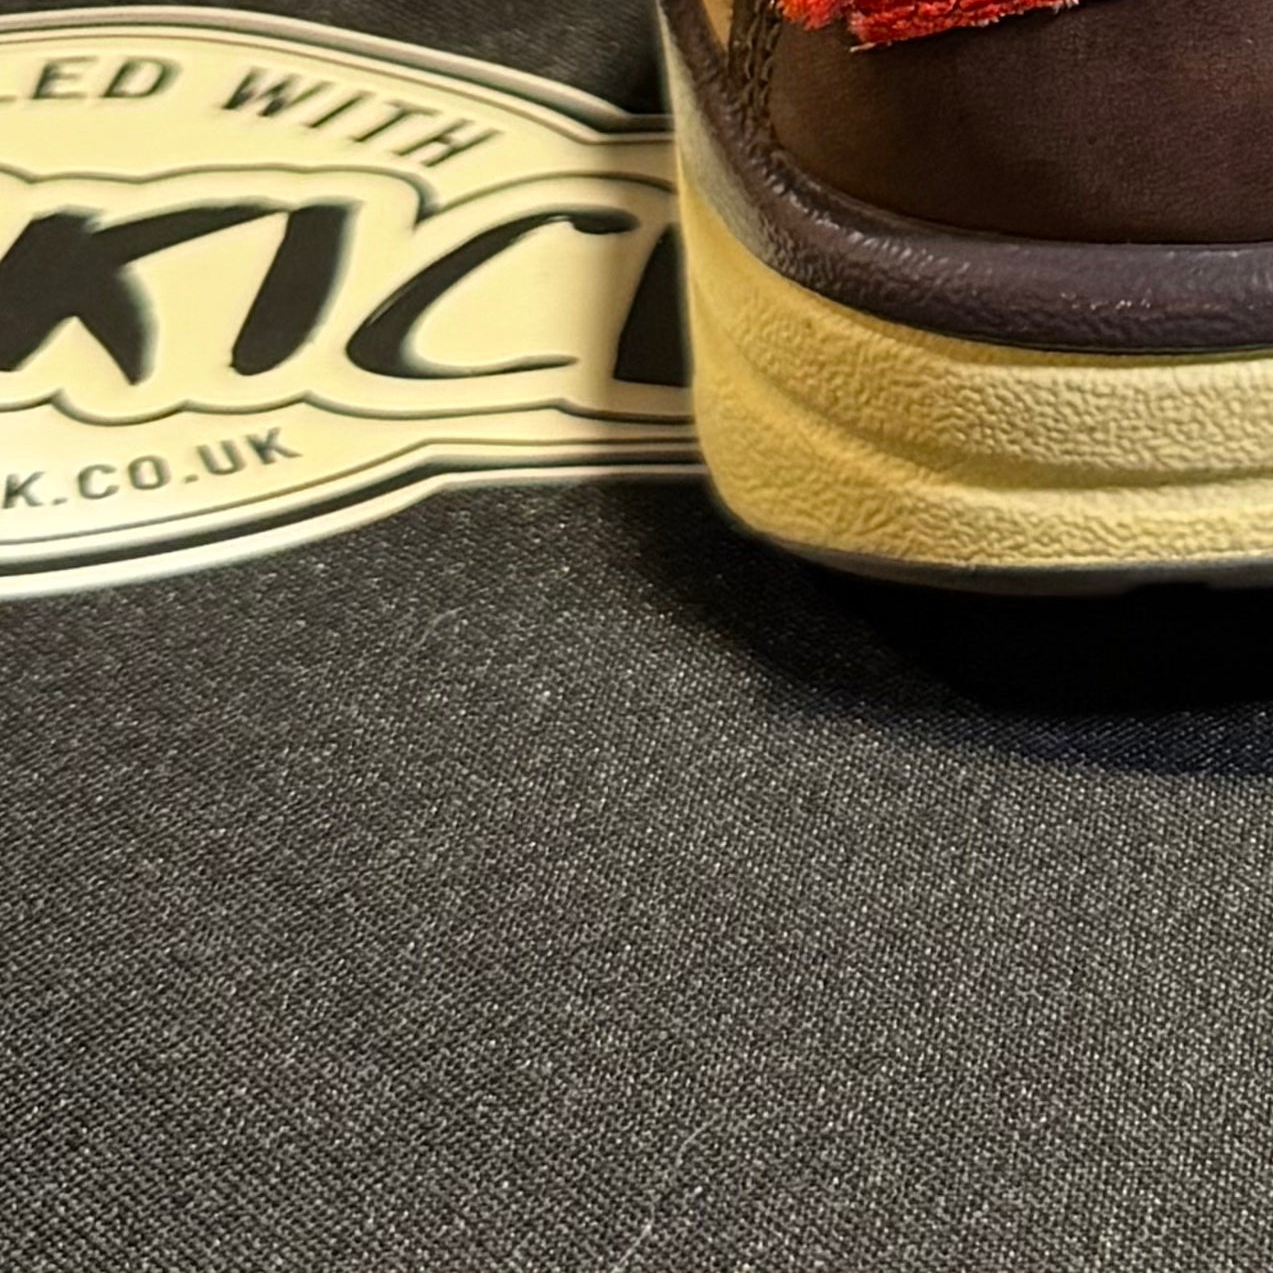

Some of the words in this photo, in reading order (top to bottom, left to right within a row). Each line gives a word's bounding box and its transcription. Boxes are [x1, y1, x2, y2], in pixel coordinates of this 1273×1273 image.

[0, 55, 182, 102] ED
[220, 66, 504, 169] WITH
[0, 197, 692, 388] KIC
